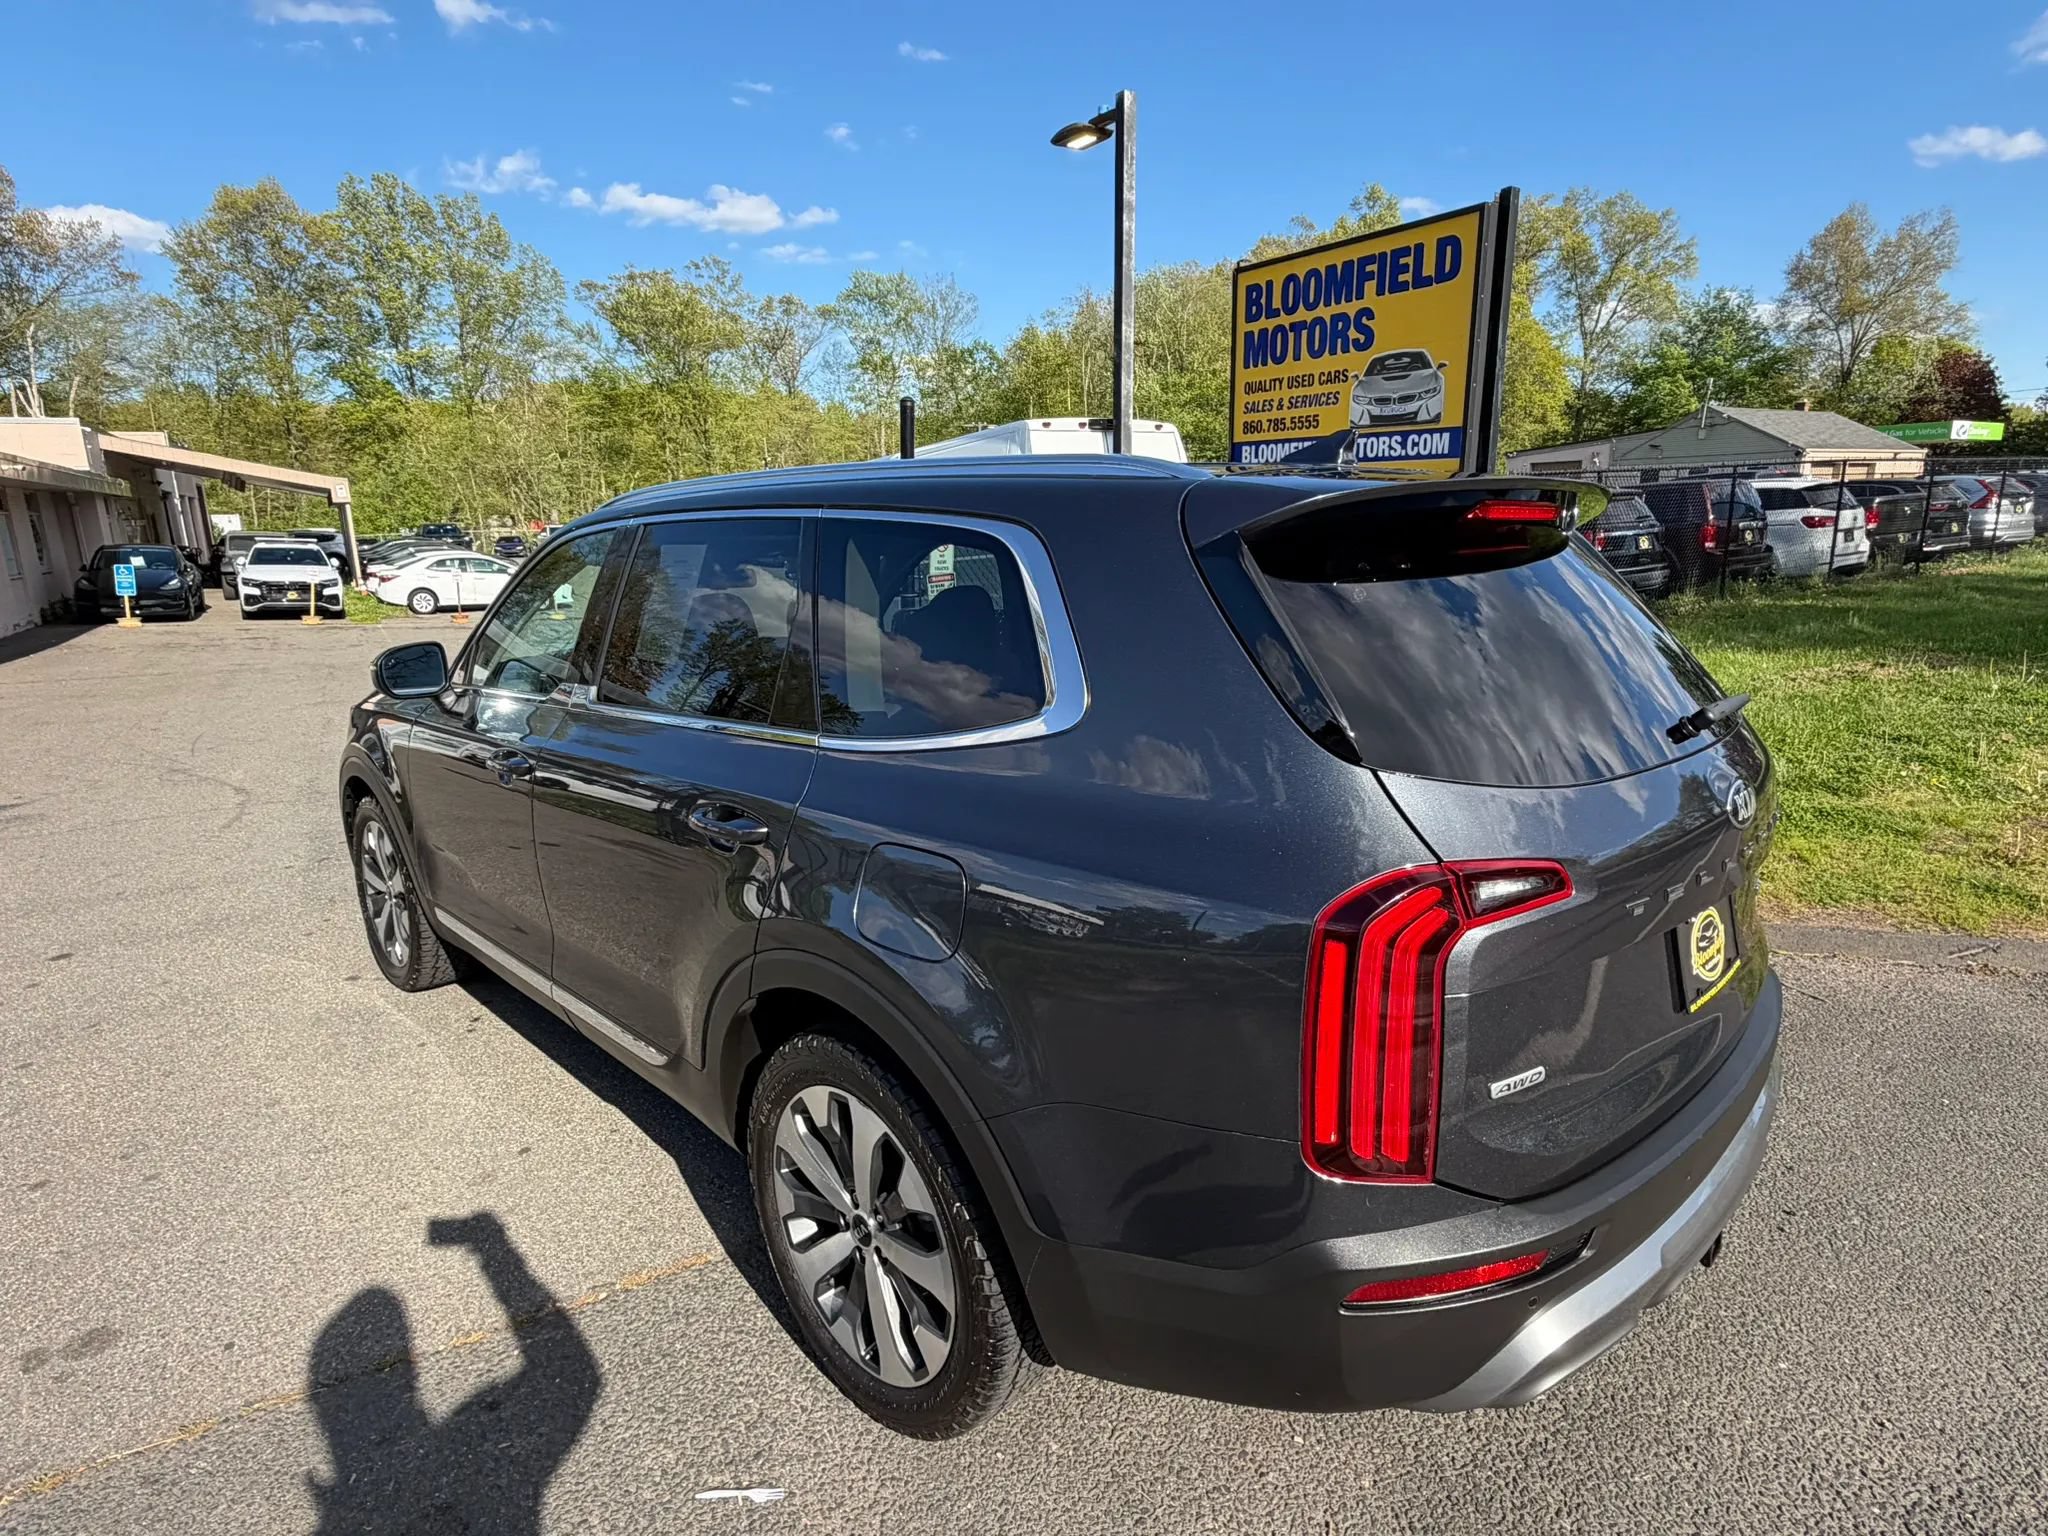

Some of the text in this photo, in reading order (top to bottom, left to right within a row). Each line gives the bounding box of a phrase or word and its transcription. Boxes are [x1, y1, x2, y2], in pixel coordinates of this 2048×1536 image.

[1244, 234, 1463, 324] BLOOMFIELD
[1243, 307, 1376, 370] MOTORS
[1244, 368, 1349, 396] QUALITY USED CARS
[1243, 390, 1341, 415] SALES & SERVICES
[1242, 414, 1320, 435] 860.785.5555
[1494, 1071, 1543, 1097] AWD
